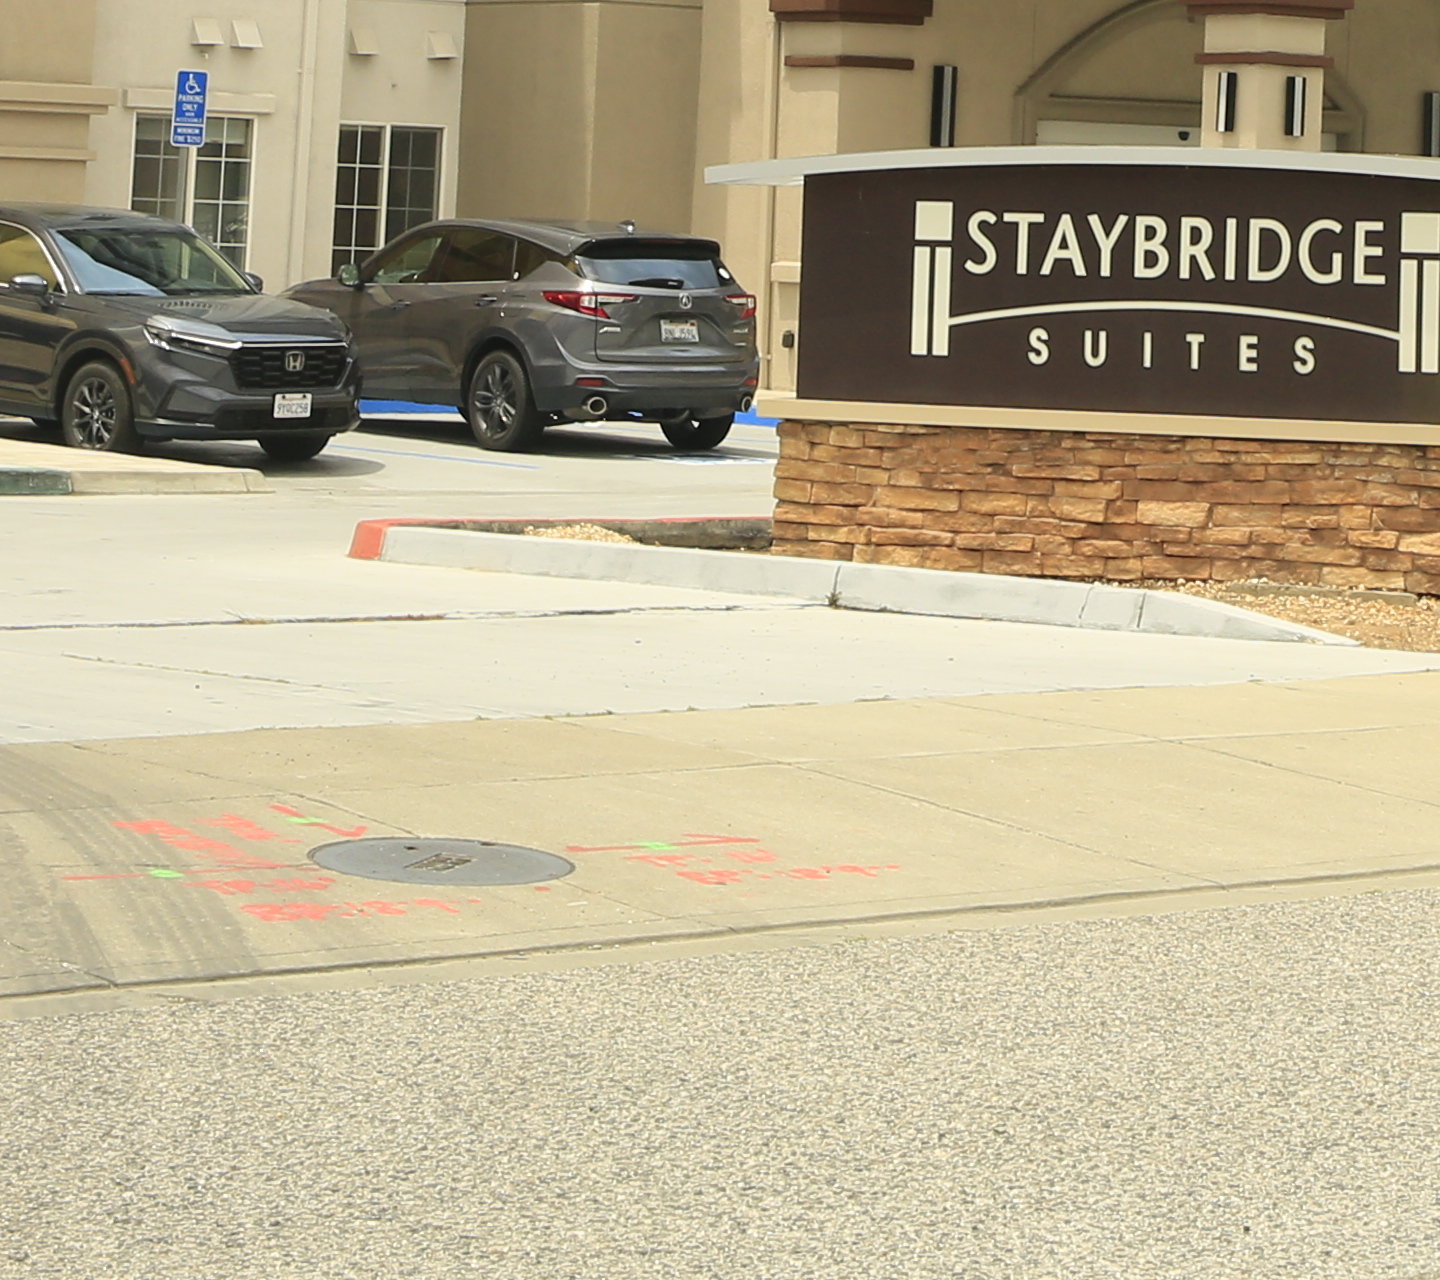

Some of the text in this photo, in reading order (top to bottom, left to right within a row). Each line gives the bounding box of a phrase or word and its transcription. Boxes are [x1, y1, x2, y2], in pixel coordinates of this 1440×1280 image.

[178, 94, 203, 102] PARKING
[182, 103, 198, 111] ONLY
[964, 210, 1387, 284] STAYBRIDGE
[1028, 327, 1316, 374] SUITES
